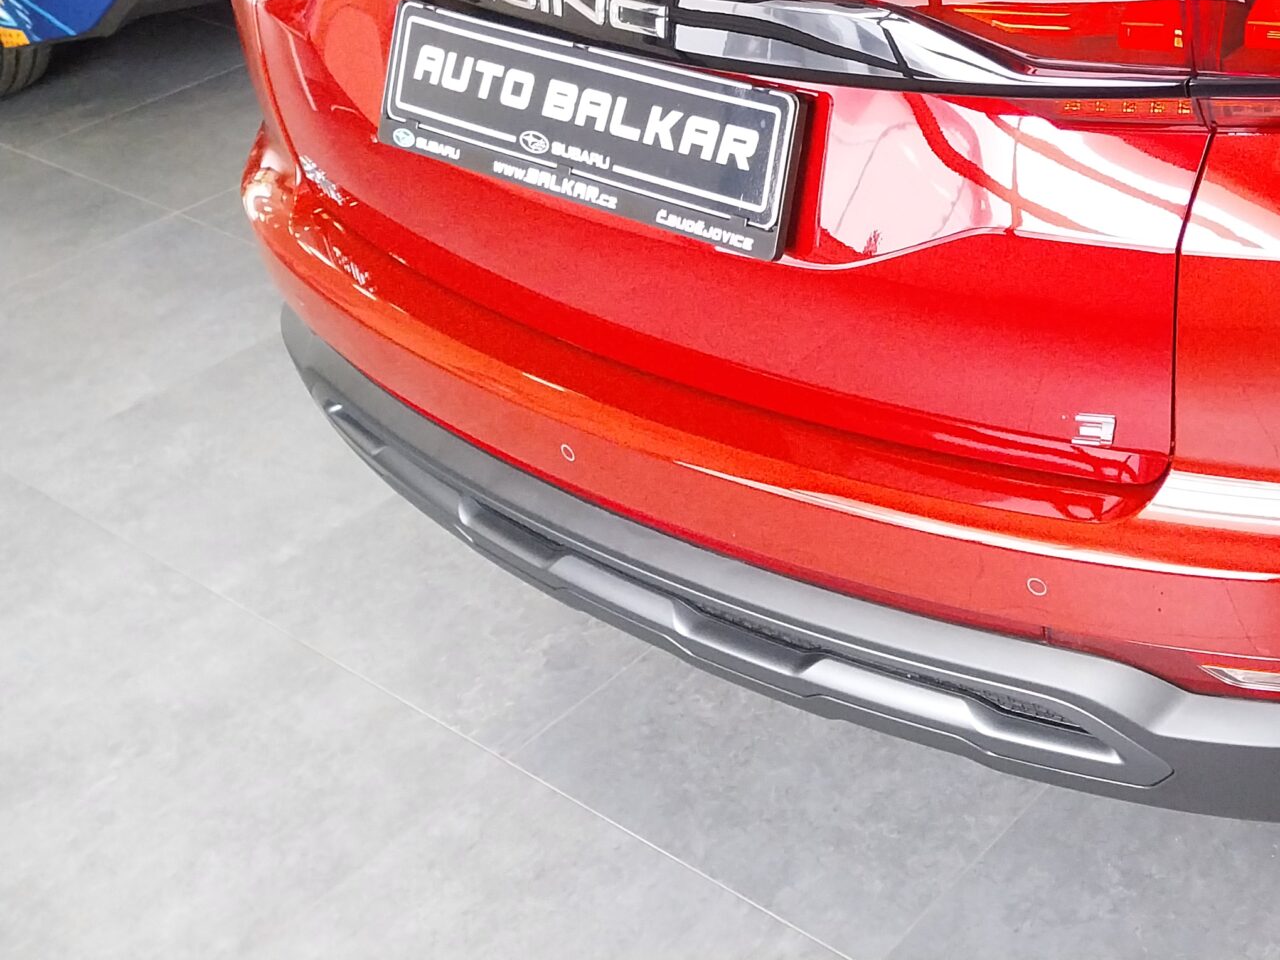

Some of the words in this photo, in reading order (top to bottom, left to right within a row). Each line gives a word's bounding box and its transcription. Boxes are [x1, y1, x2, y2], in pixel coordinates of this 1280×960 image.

[413, 45, 535, 110] AUTO
[541, 78, 760, 171] BALKAR
[415, 136, 461, 160] SUBARU
[551, 141, 610, 170] SUBARU
[492, 160, 618, 210] www.BALKAR.cz
